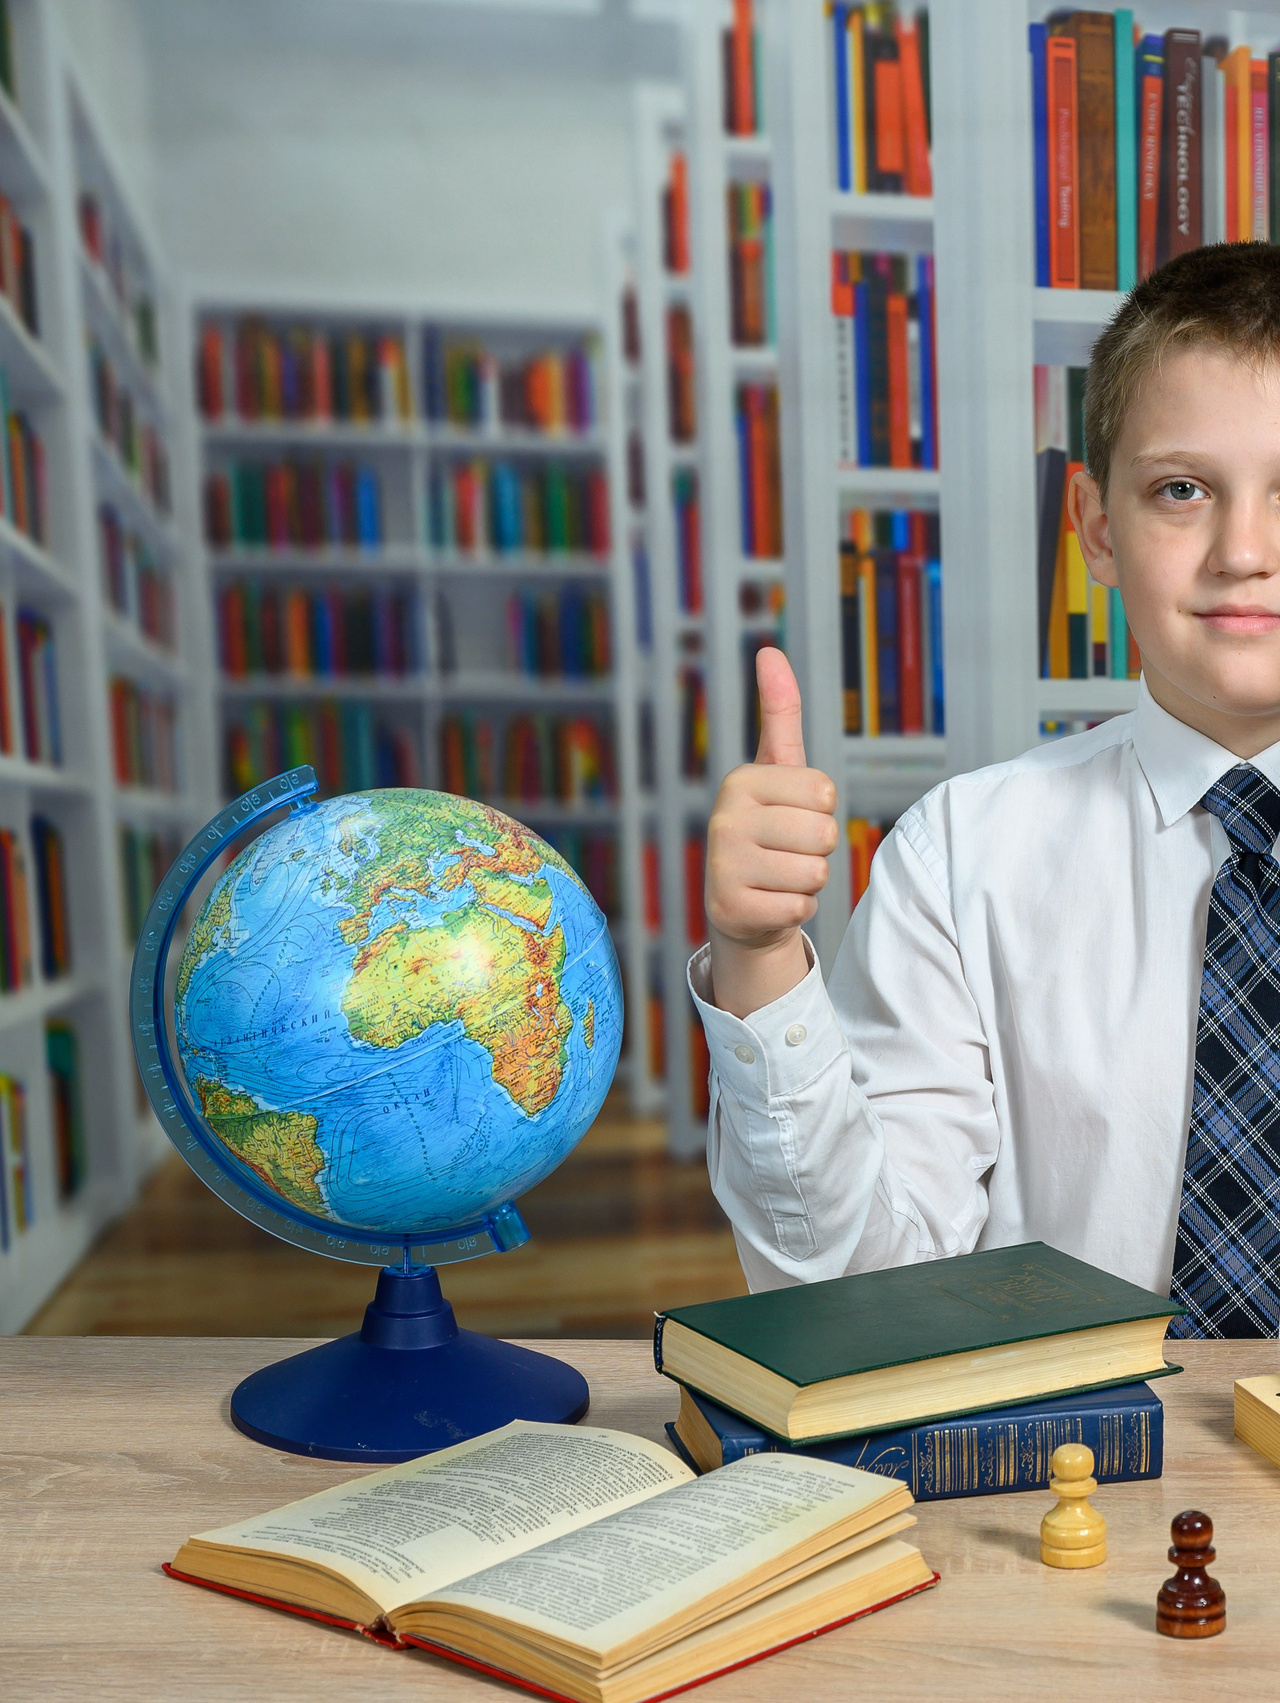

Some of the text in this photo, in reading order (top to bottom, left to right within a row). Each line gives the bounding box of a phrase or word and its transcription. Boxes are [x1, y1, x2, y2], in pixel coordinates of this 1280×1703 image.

[1176, 83, 1191, 236] TECHNOLOGY
[1057, 184, 1073, 228] Testing
[212, 1008, 332, 1048] АТЛАНТИЧЕСКИЙ
[382, 1087, 431, 1114] ОКЕАН
